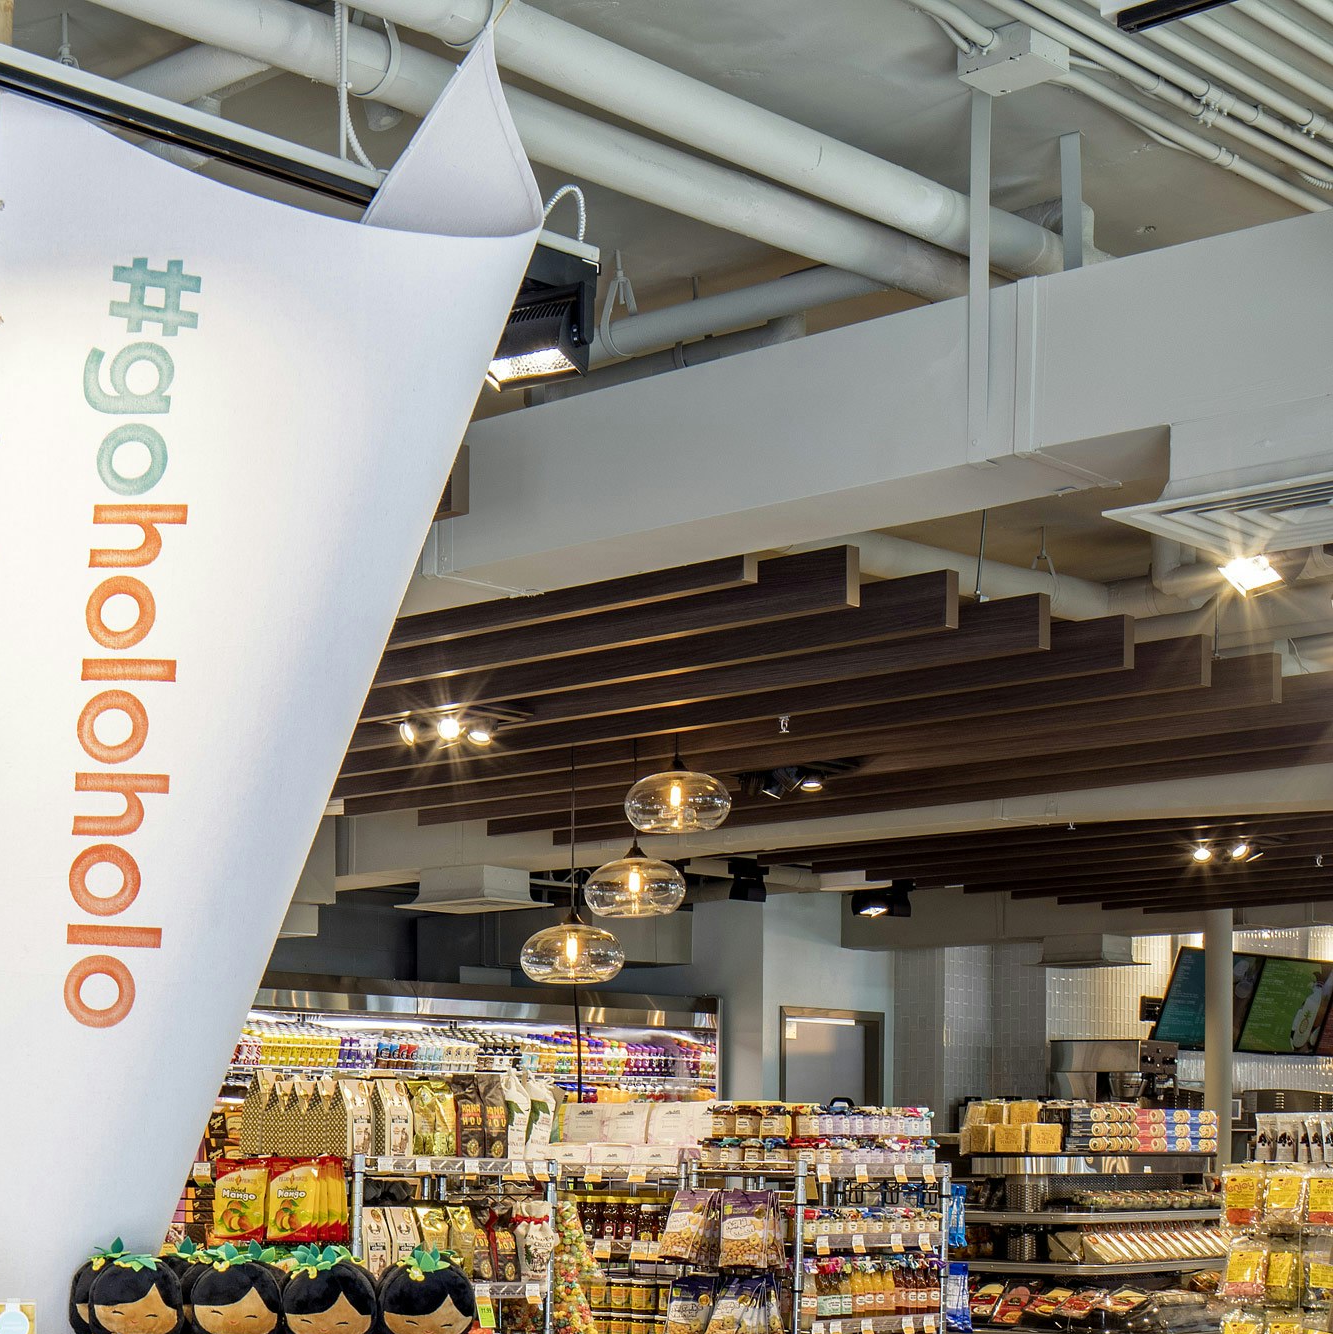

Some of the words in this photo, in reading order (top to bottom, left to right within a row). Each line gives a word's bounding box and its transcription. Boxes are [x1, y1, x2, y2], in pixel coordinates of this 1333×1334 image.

[62, 256, 203, 1030] #goholoholo
[461, 1104, 481, 1113] HANA
[462, 1117, 482, 1127] HOU
[1227, 1180, 1256, 1194] enjoy
[222, 1189, 258, 1201] Mango
[277, 1188, 308, 1199] Mango
